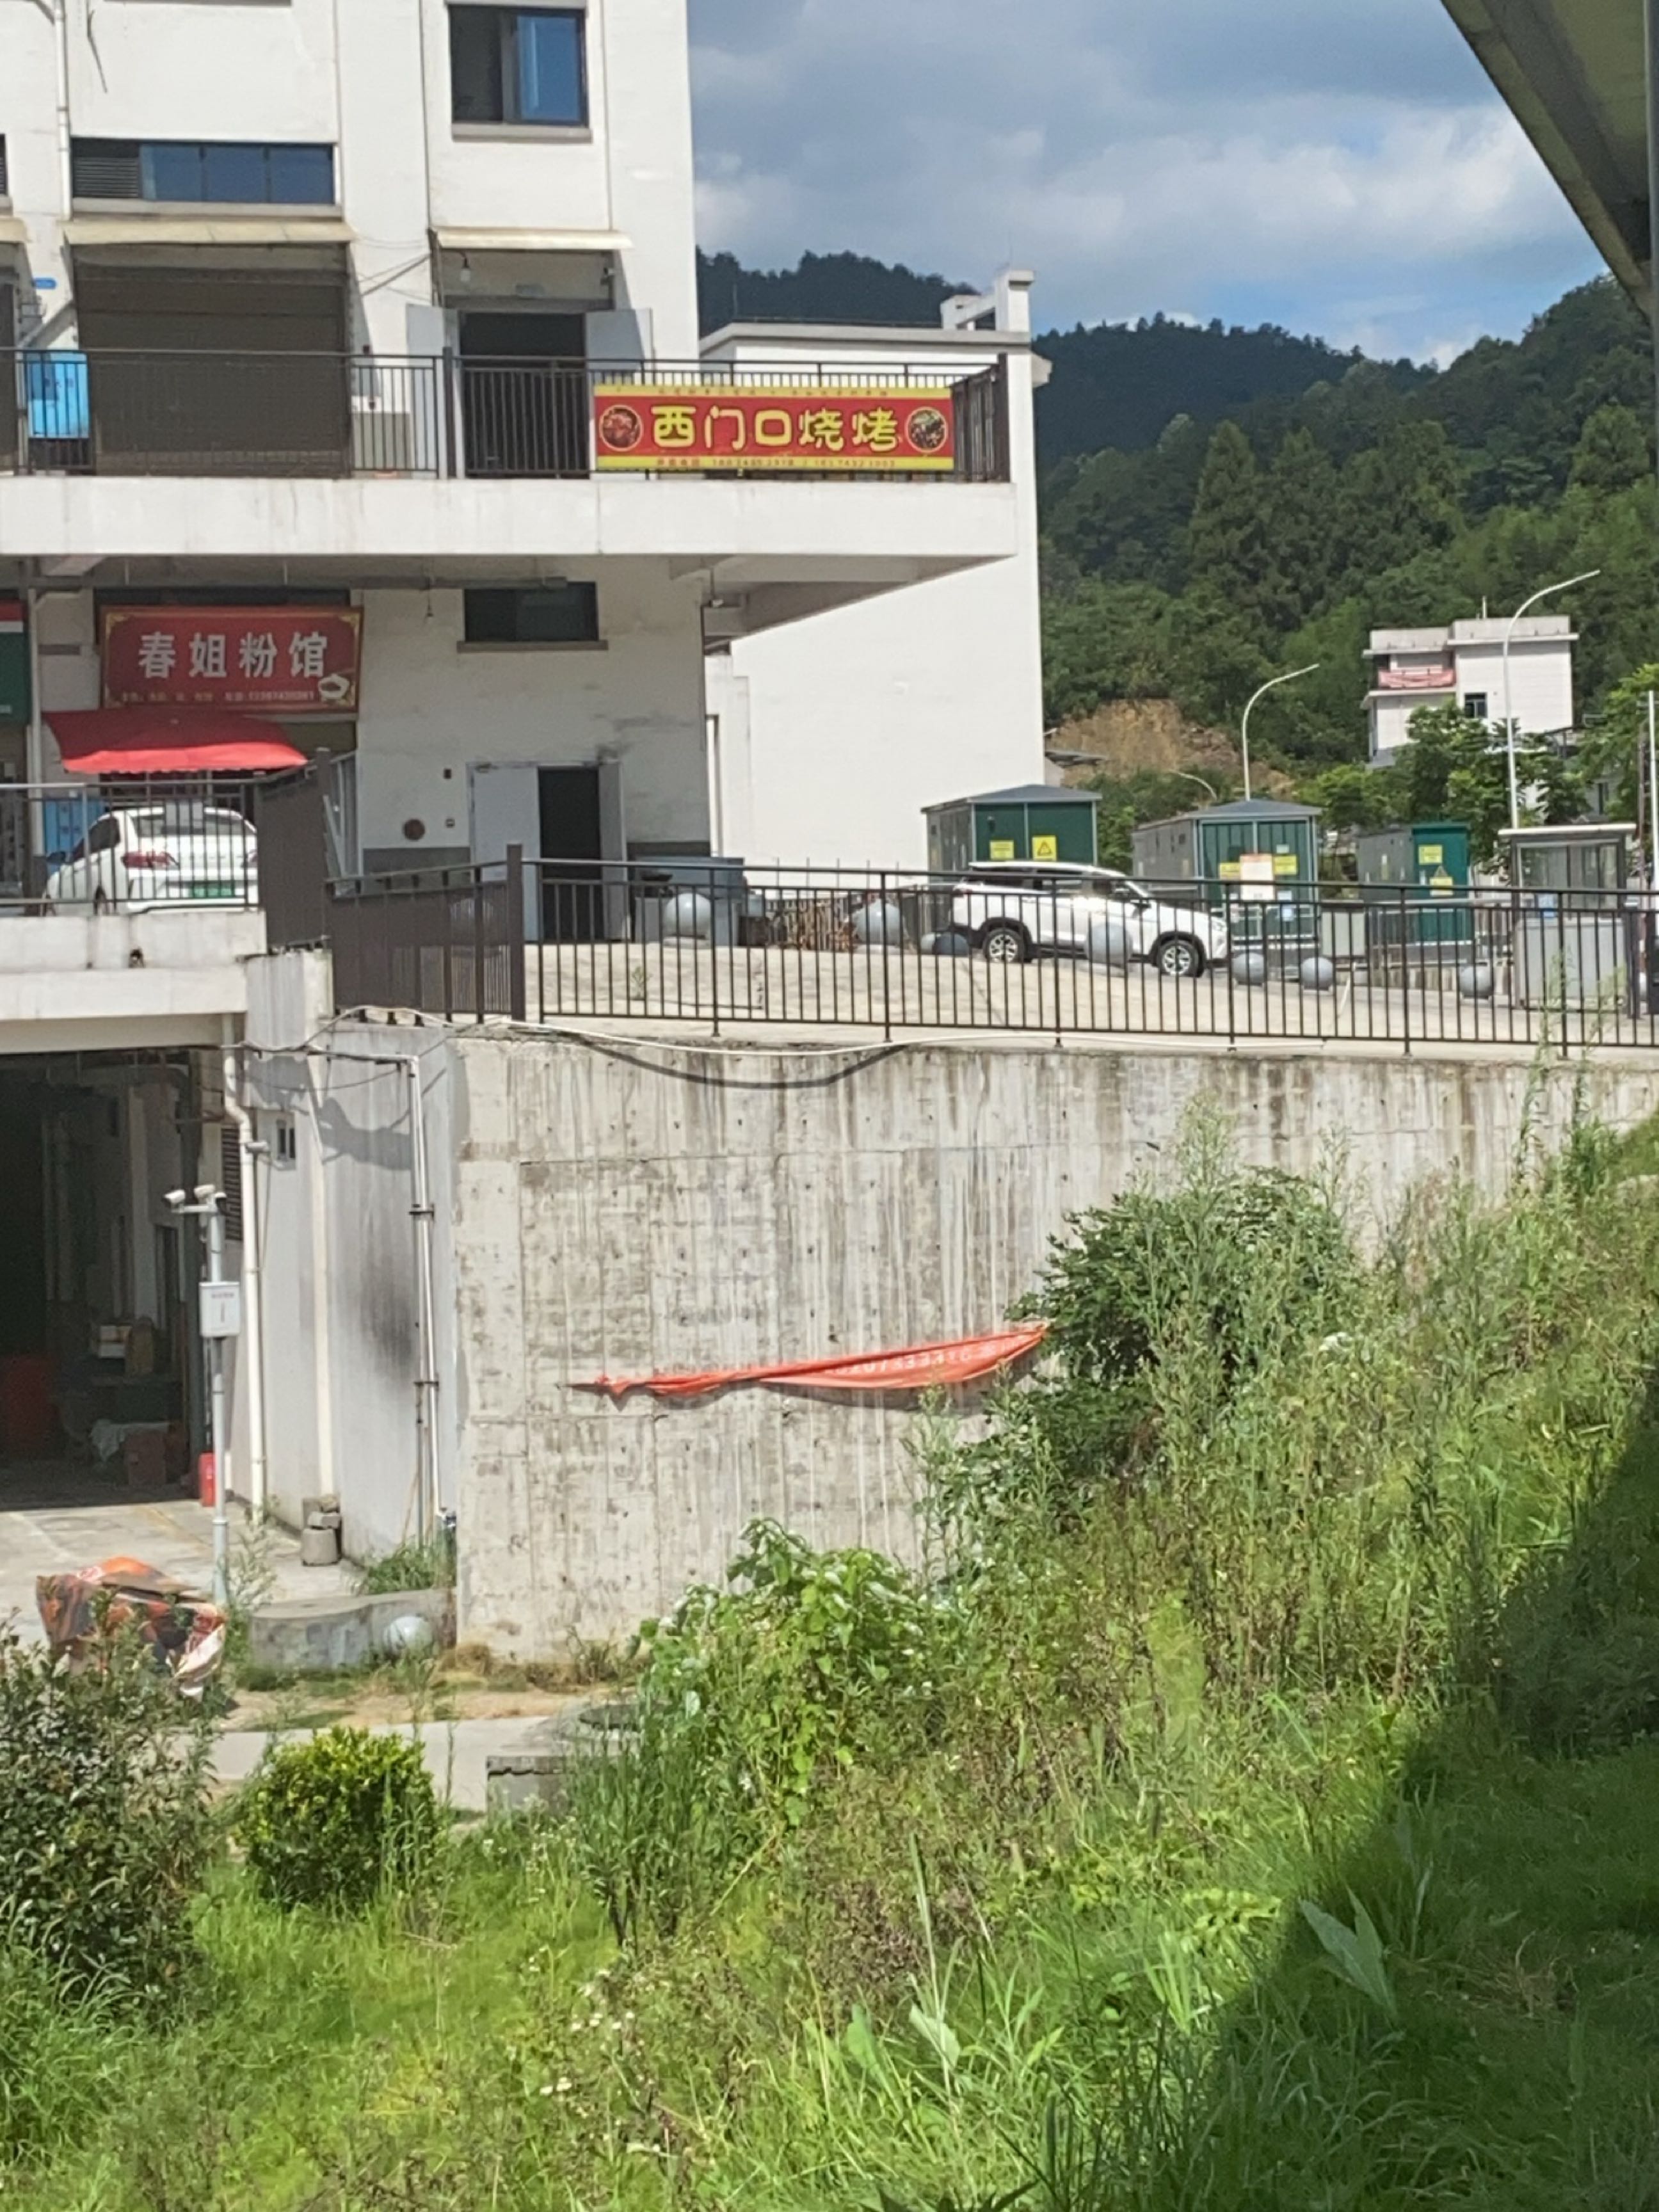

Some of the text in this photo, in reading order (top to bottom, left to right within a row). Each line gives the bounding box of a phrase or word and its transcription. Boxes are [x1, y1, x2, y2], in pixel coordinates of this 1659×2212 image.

[651, 405, 898, 451] 西门口烧烤
[138, 631, 328, 678] 春姐粉馆
